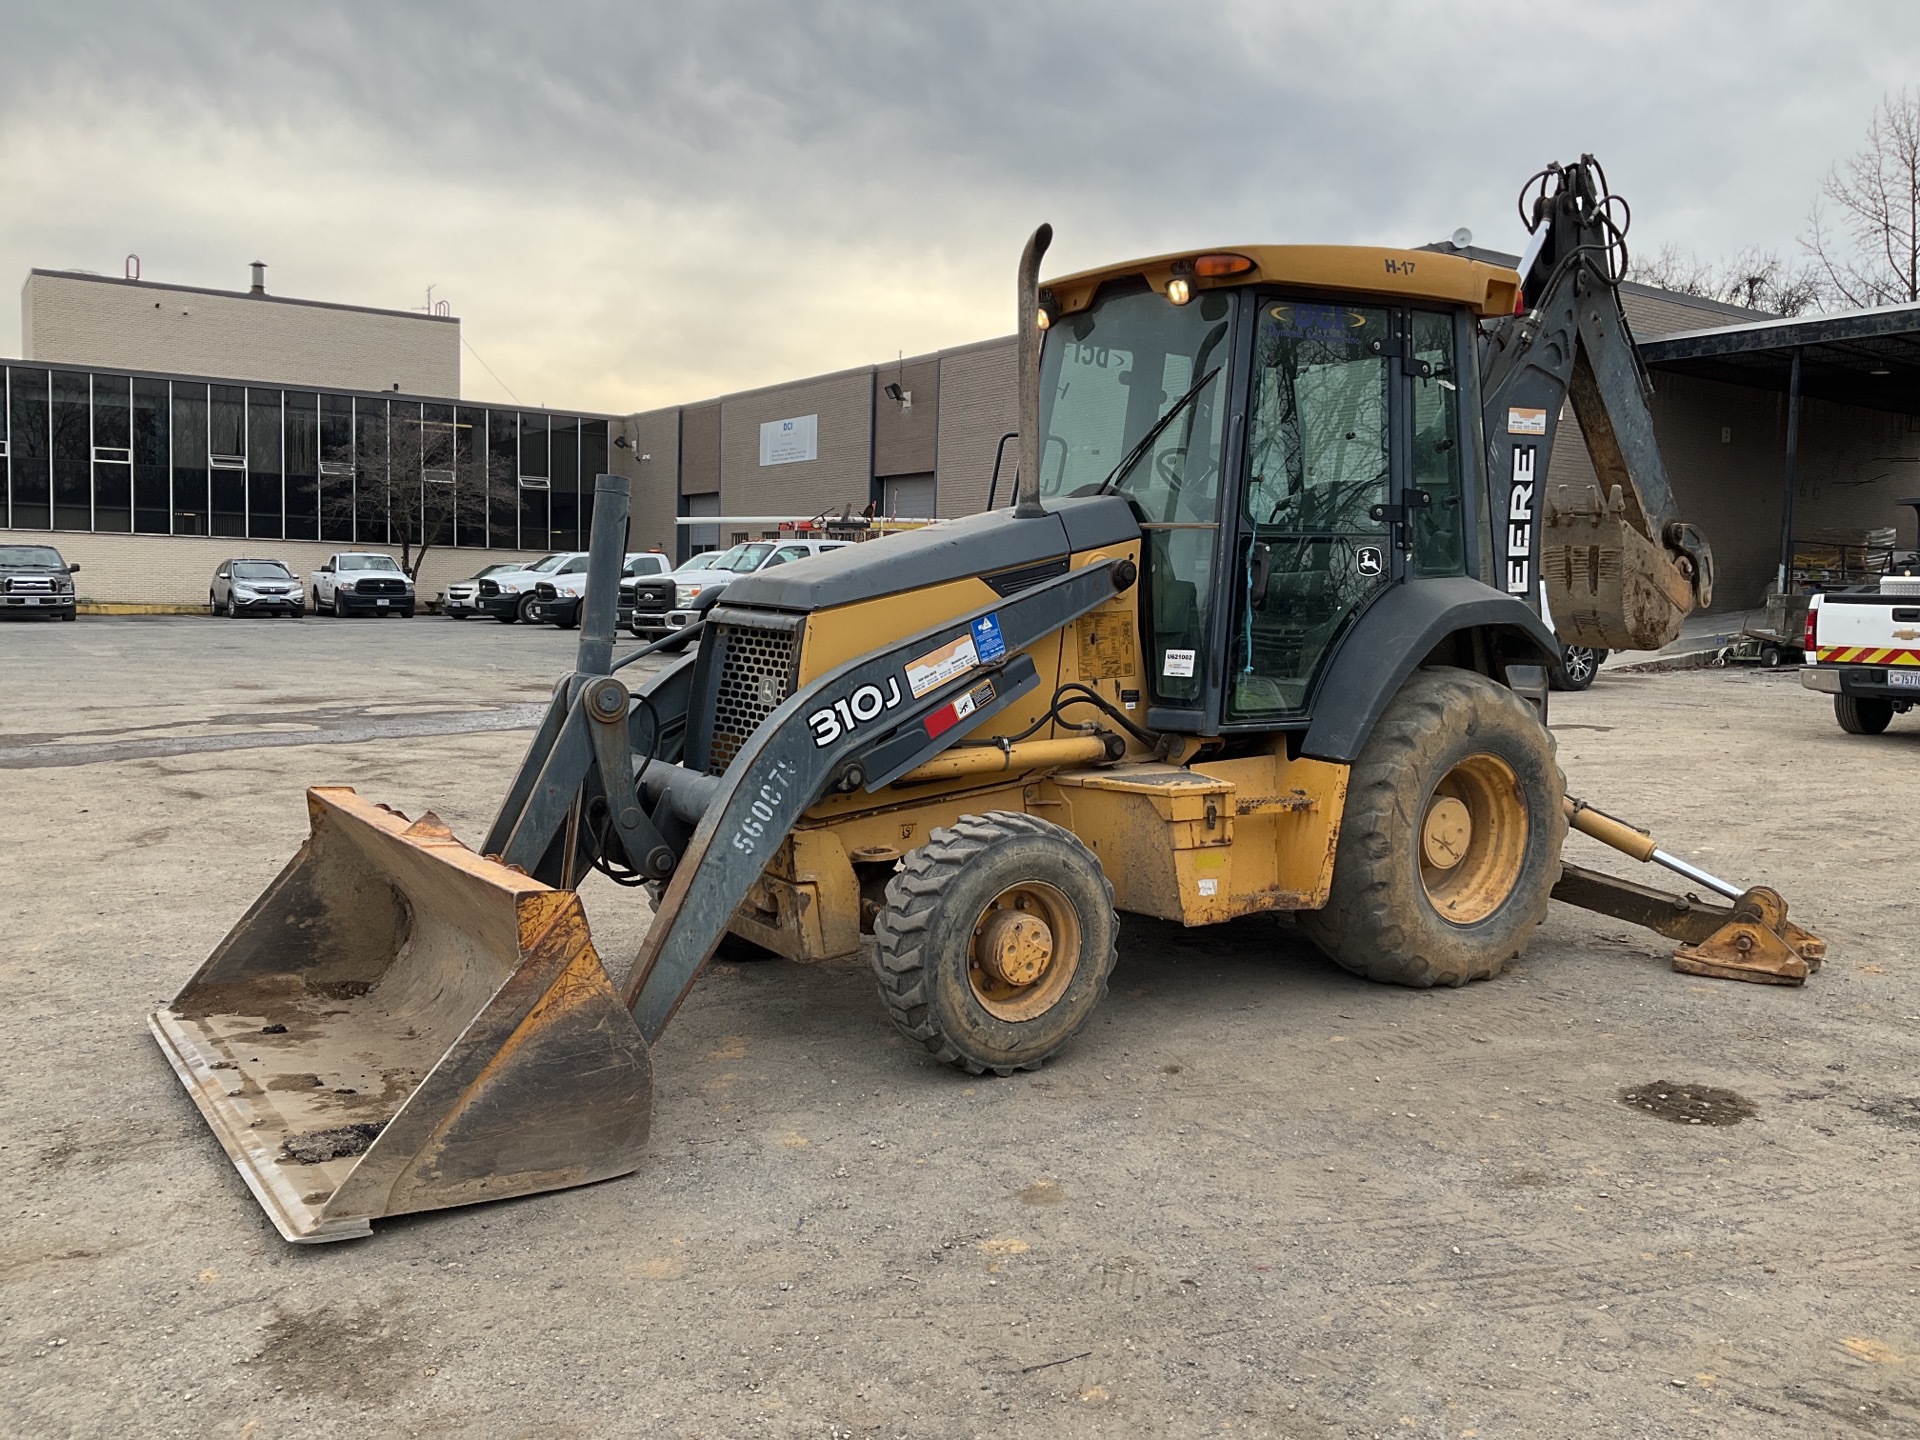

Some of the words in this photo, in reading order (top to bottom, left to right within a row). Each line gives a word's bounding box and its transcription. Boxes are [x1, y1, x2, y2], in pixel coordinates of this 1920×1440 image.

[1384, 258, 1416, 276] H-17
[783, 422, 793, 431] DCI
[1507, 448, 1535, 600] EERE
[808, 676, 902, 747] 310J
